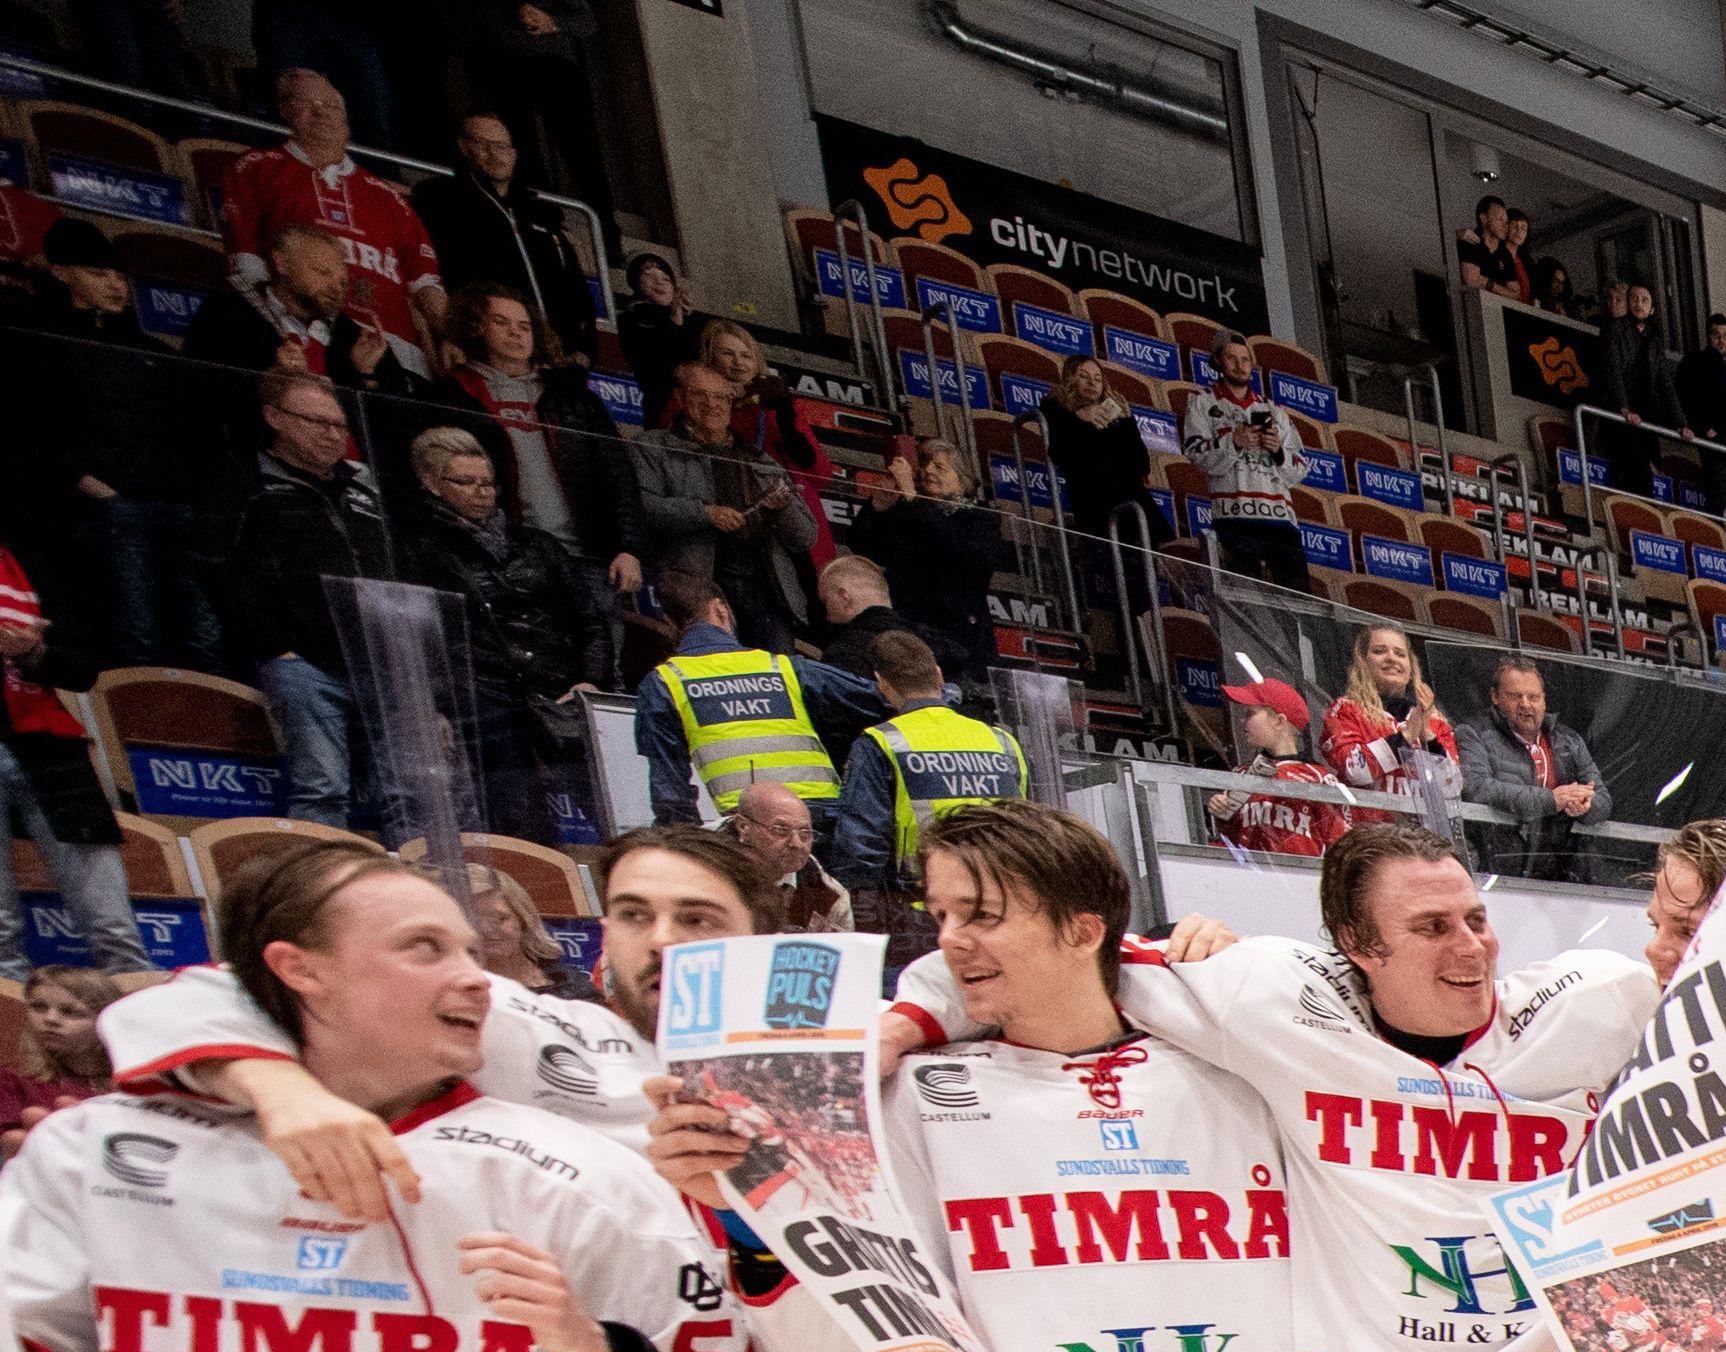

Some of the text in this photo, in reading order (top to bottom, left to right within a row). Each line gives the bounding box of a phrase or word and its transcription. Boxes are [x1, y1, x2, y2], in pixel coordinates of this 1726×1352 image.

[990, 215, 1239, 312] citynetwork
[928, 288, 989, 318] NKT
[1024, 312, 1083, 343] NKT
[1114, 336, 1170, 366] NKT
[1278, 380, 1329, 409] NKT
[1365, 469, 1415, 496] NKT
[1370, 543, 1422, 569] NKT
[1638, 539, 1678, 561] NKT
[1451, 561, 1500, 585] NKT
[687, 676, 784, 699] ORDNINGS
[720, 699, 772, 717] VAKT
[150, 759, 280, 794] NKT
[942, 774, 1001, 796] VAKT
[672, 951, 721, 1030] ST
[769, 972, 832, 1011] PULS
[1509, 970, 1583, 1042] stadium
[1292, 1016, 1352, 1034] CASTELLUM
[920, 1112, 992, 1122] CASTELLUM
[1103, 1122, 1136, 1149] ST
[433, 1126, 579, 1181] stadium
[945, 1163, 1290, 1273] TIMRÅ
[302, 1237, 345, 1269] ST
[1399, 1316, 1491, 1343] Hall &
